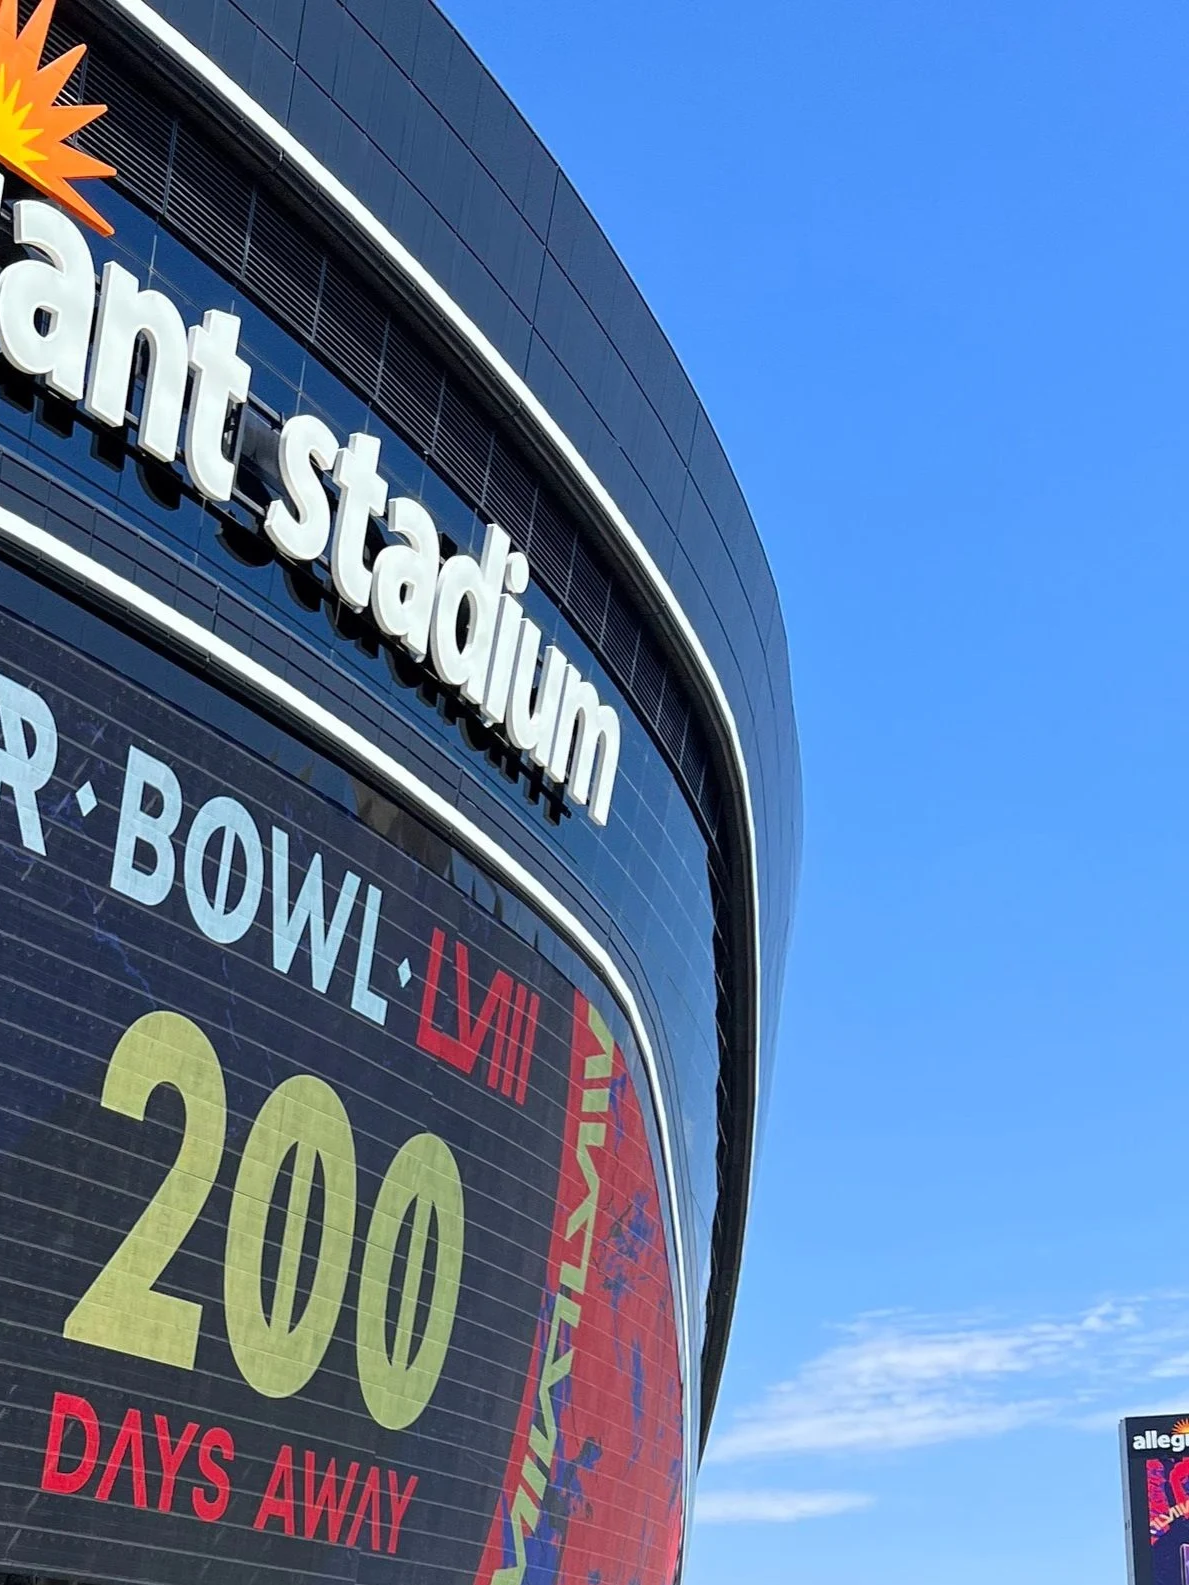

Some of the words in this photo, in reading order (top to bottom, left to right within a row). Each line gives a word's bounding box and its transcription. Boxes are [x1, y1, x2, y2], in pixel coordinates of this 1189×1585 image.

[265, 432, 620, 826] stadium
[110, 744, 387, 1026] BOWL
[416, 927, 540, 1105] LVIII
[62, 1010, 465, 1431] 200
[41, 1391, 235, 1522] DAYS
[253, 1444, 418, 1555] AWAY
